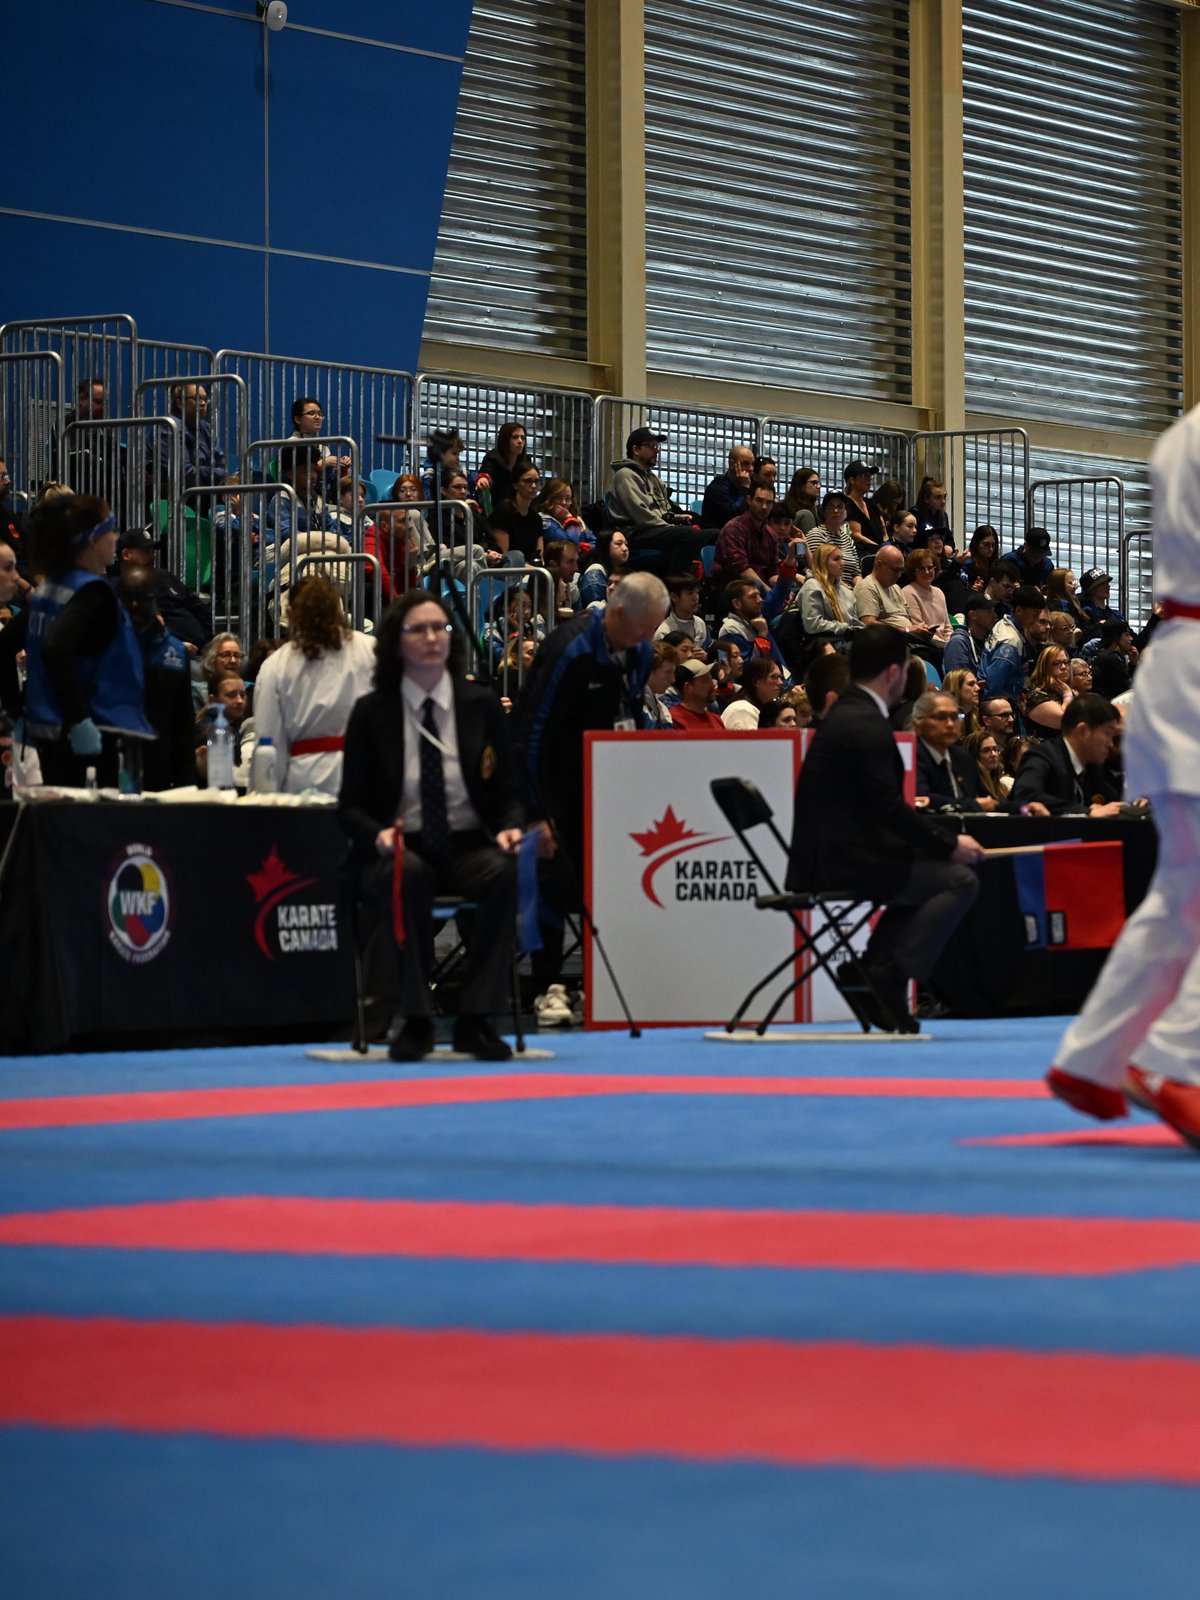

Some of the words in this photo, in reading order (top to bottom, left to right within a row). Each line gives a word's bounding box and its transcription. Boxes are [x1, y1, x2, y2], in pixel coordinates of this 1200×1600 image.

[676, 861, 758, 880] KARATE
[120, 891, 157, 916] WKF
[676, 882, 759, 901] CANADA
[277, 904, 336, 928] KARATE
[278, 928, 339, 952] CANADA
